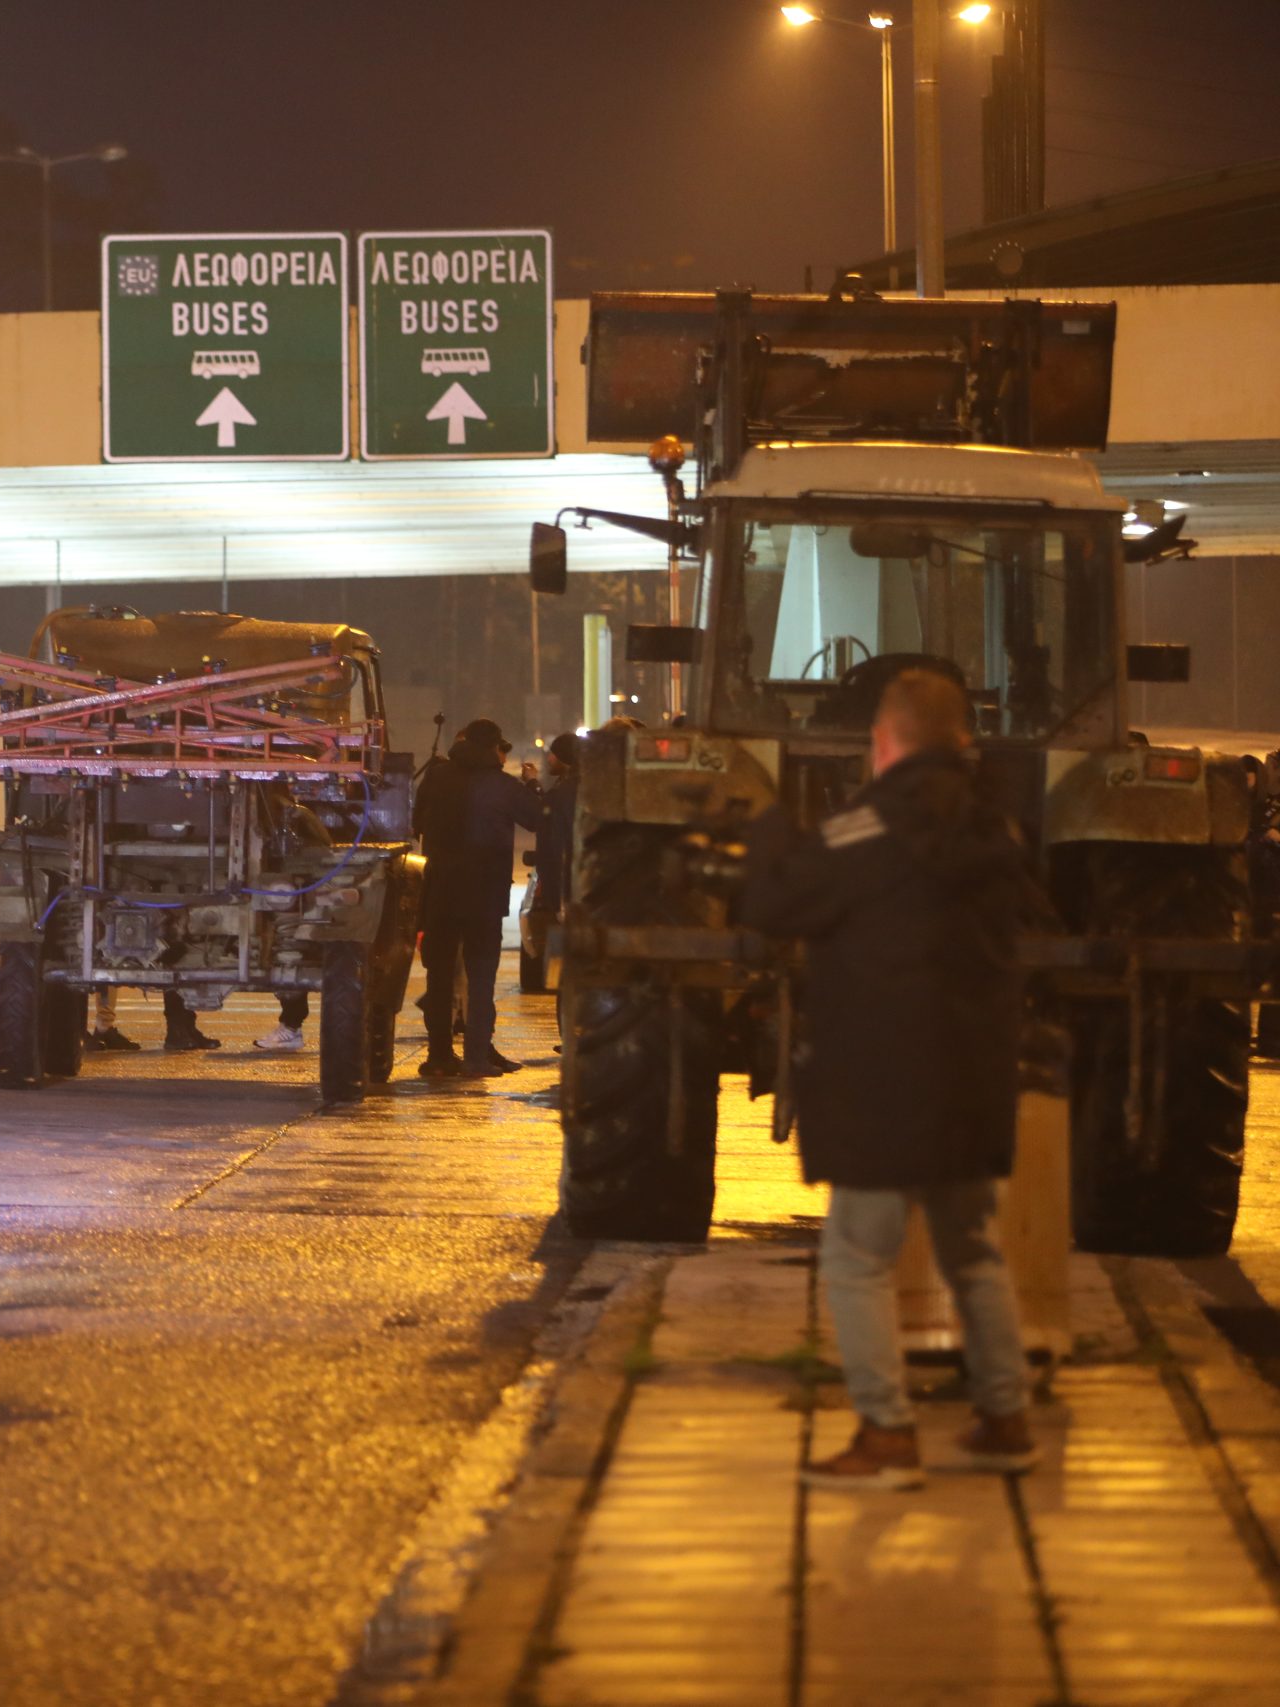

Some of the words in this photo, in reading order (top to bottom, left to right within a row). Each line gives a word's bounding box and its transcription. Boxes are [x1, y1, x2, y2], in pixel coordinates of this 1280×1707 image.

[126, 268, 152, 284] EU
[172, 251, 337, 287] ΛΕΩΦΟΡΕΙΑ
[371, 249, 538, 285] ΛΕΩΦΟΡΕΙΑ
[172, 301, 269, 336] BUSES
[401, 299, 499, 335] BUSES
